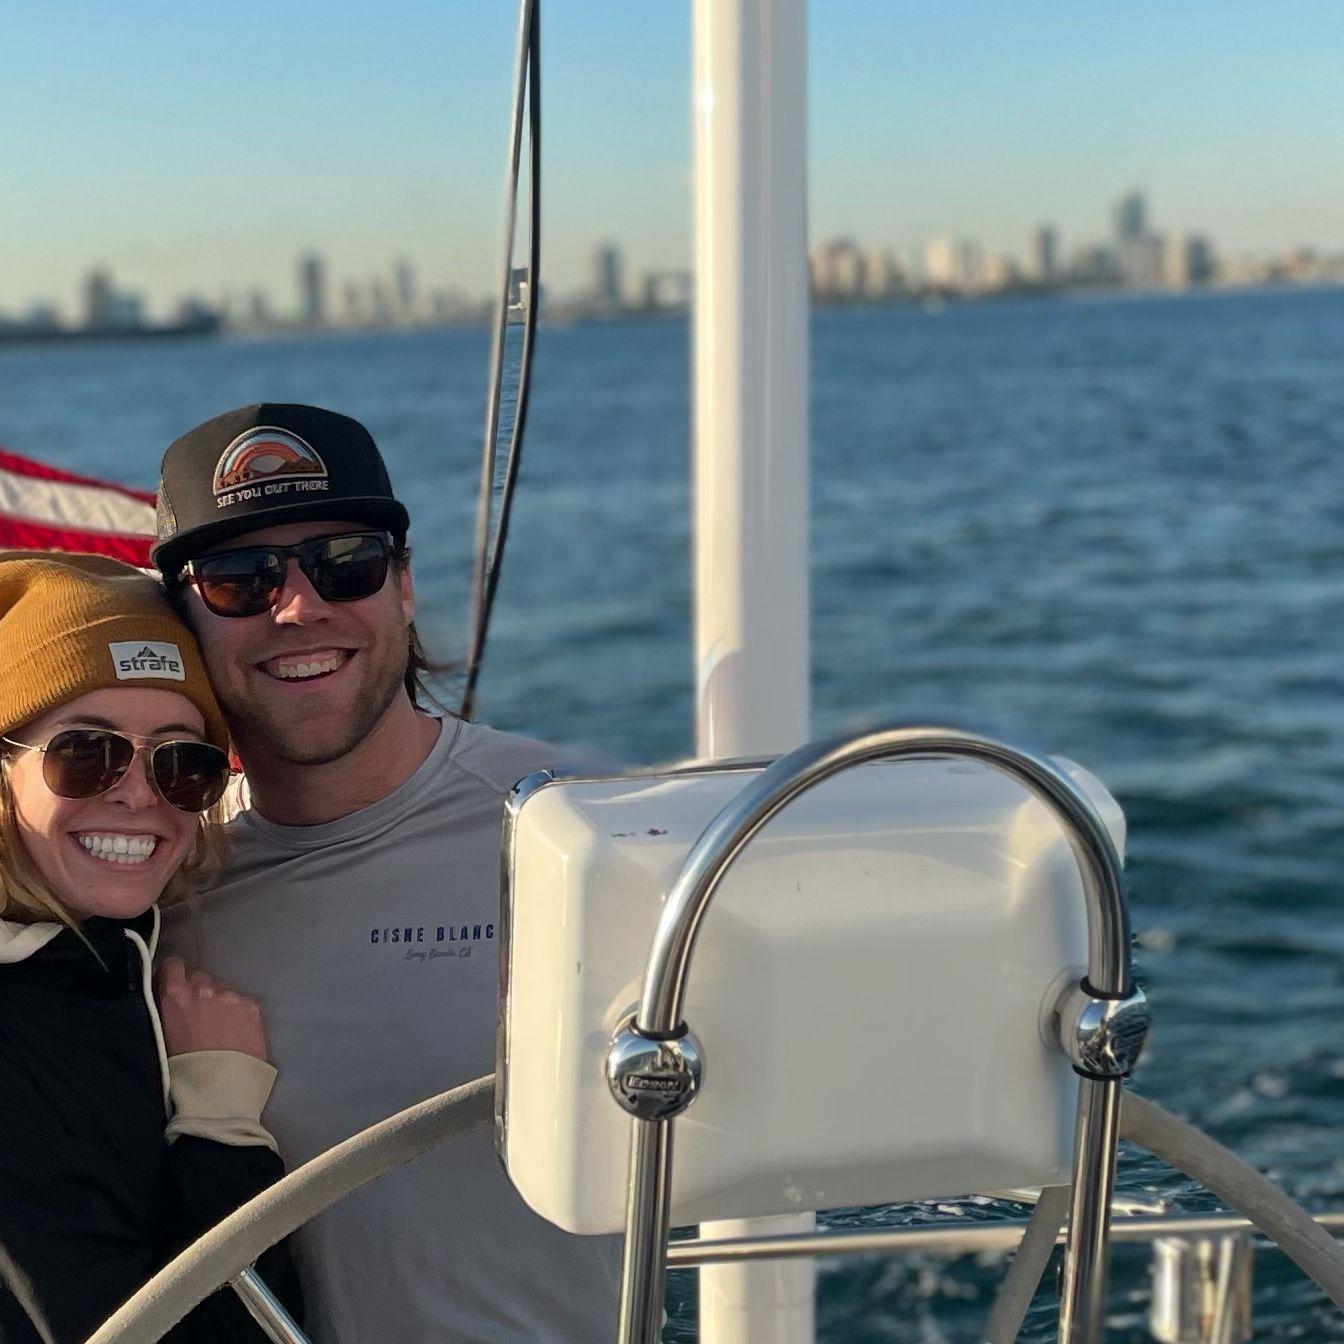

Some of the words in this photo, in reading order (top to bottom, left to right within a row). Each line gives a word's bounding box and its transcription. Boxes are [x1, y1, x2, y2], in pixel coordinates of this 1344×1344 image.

[216, 494, 235, 509] SEE
[237, 486, 262, 502] YOU
[264, 482, 290, 495] OUT
[294, 480, 330, 492] THERE
[119, 655, 181, 673] strafe
[370, 927, 425, 944] CISNE
